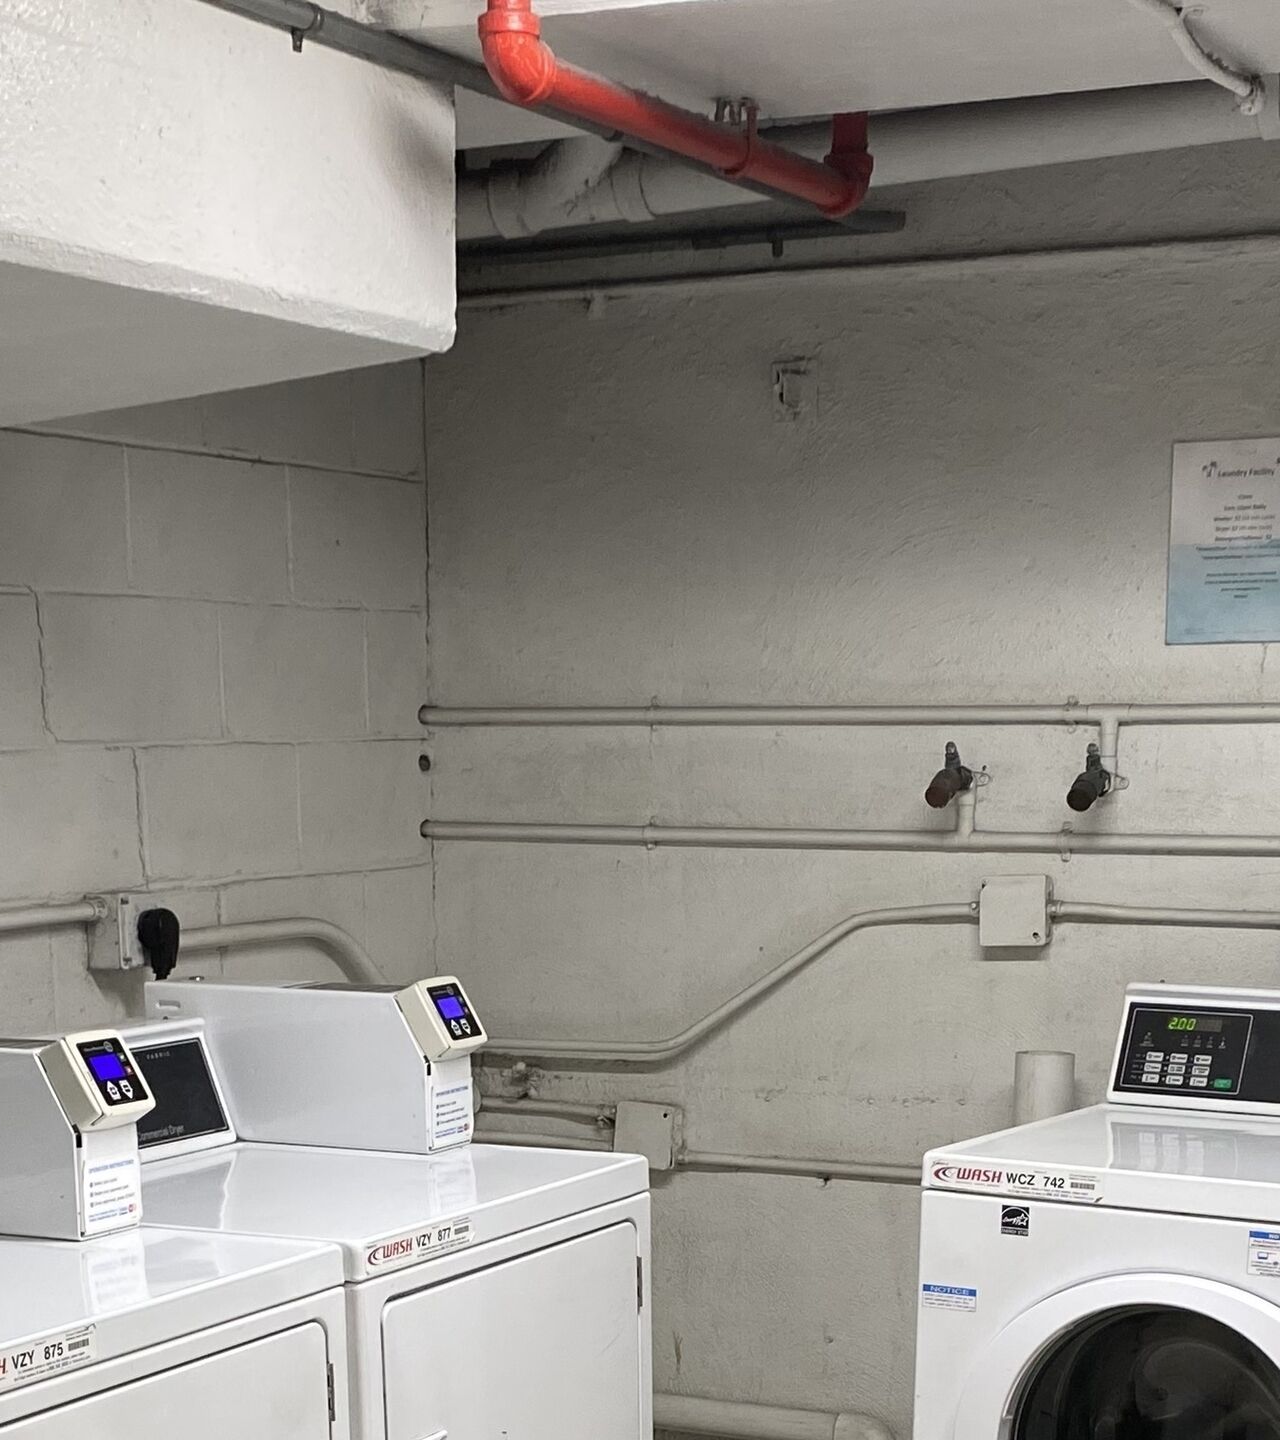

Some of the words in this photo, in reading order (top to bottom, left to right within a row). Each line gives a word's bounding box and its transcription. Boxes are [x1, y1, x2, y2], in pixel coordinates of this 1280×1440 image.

[1168, 1017, 1197, 1031] 2.00
[956, 1167, 1003, 1184] WASH
[1006, 1172, 1036, 1186] WCZ
[1043, 1176, 1065, 1189] 742
[382, 1237, 413, 1259] WASH
[415, 1232, 432, 1247] VZY
[438, 1227, 451, 1241] 877
[930, 1285, 969, 1296] NOTICE
[11, 1350, 35, 1370] VZY
[43, 1342, 64, 1360] 875
